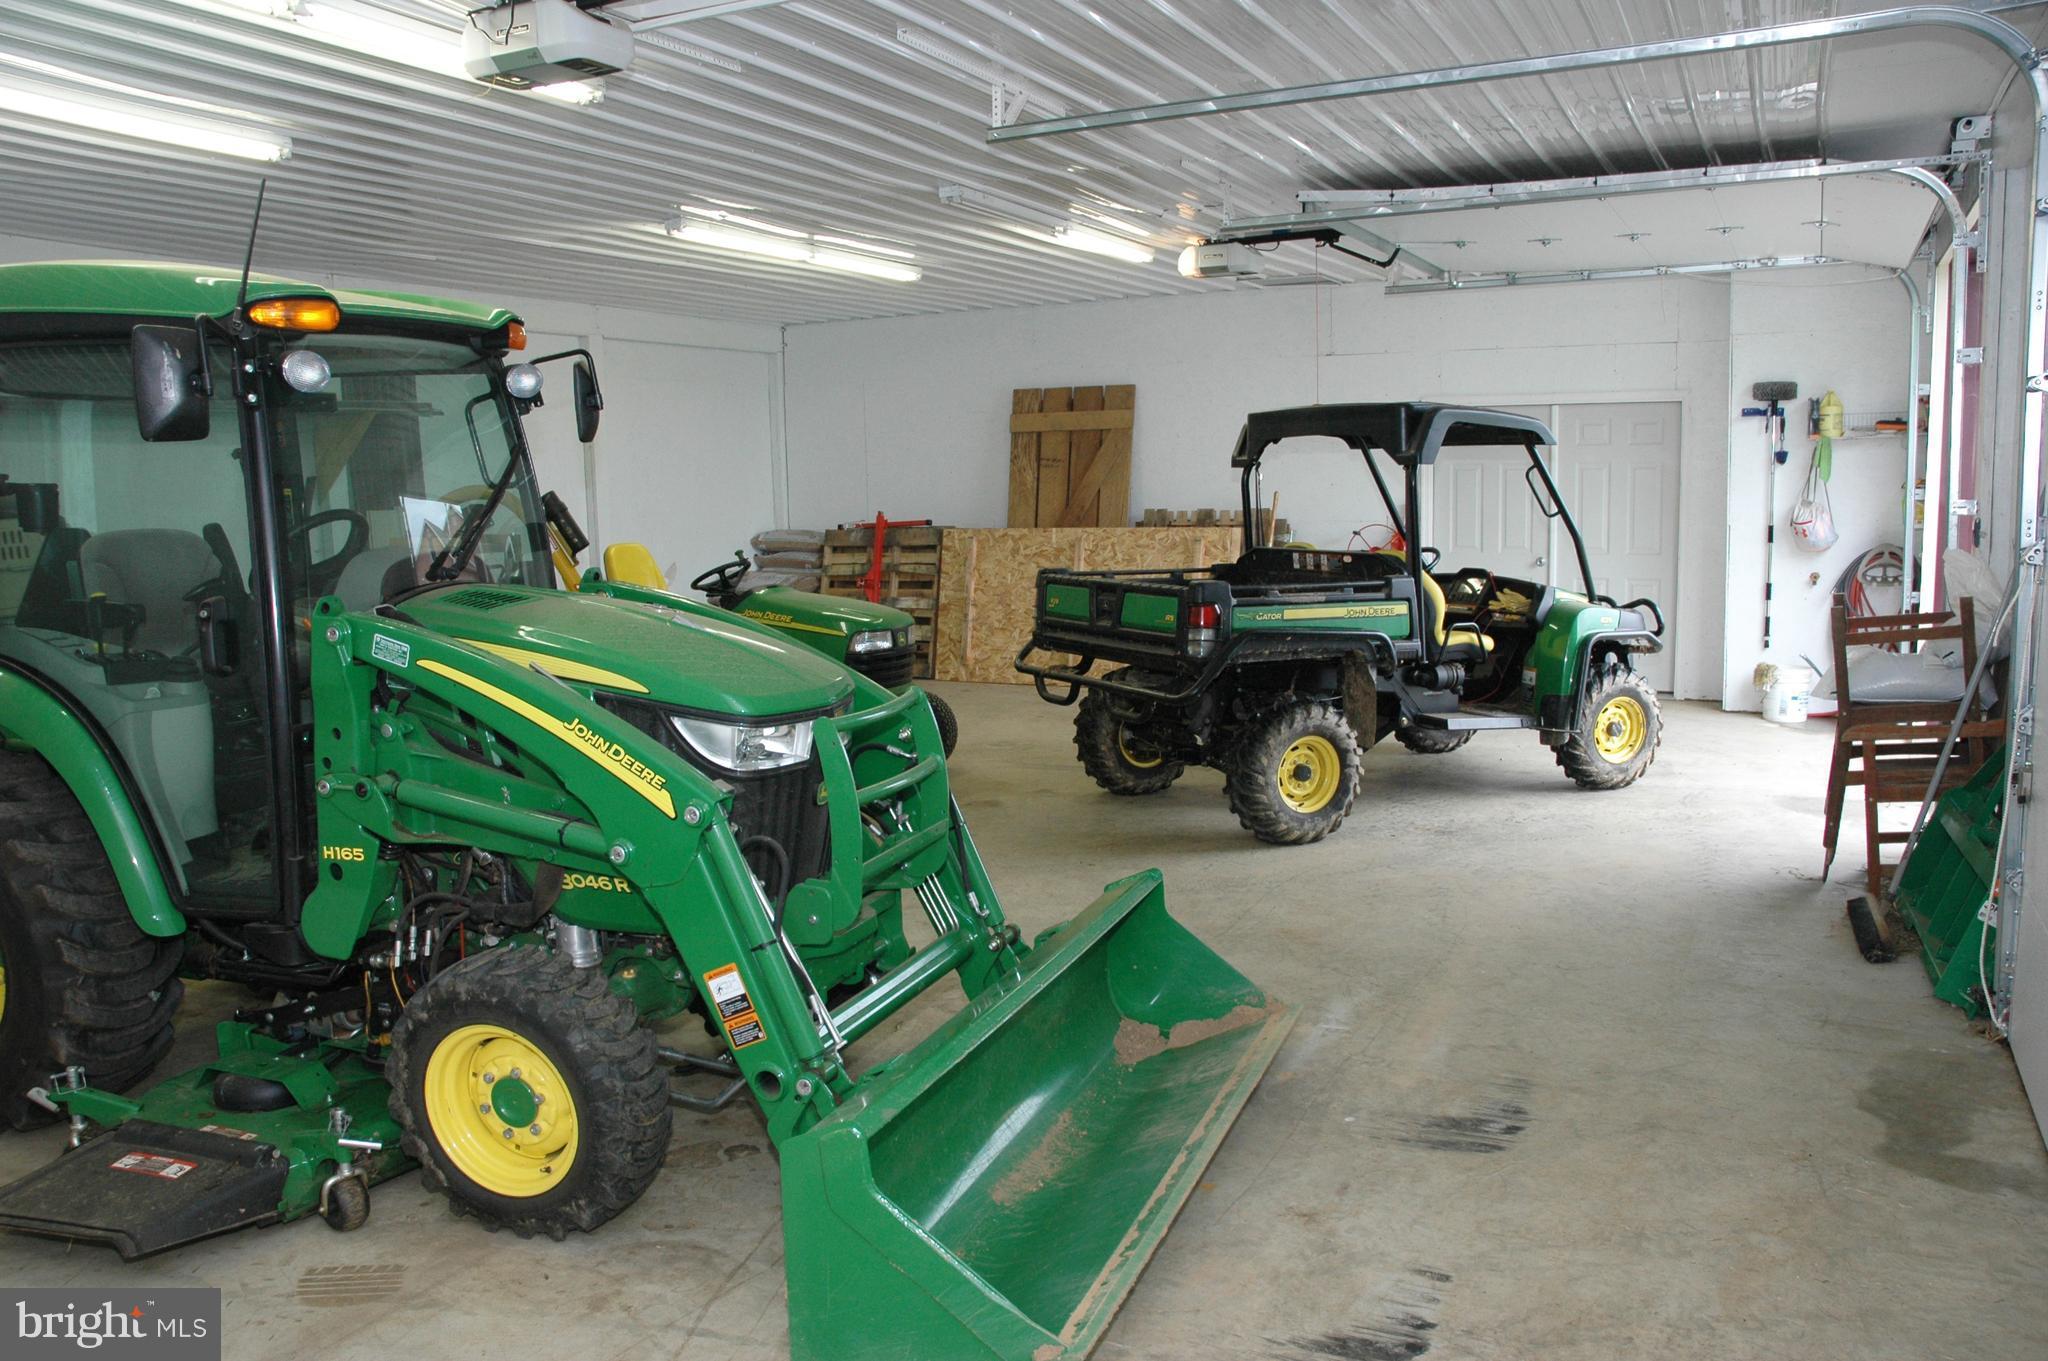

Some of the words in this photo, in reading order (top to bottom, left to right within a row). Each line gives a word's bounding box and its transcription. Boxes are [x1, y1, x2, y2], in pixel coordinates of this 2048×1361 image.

[742, 609, 764, 619] JOHN
[764, 611, 793, 623] DEERE
[1344, 608, 1367, 618] JOHN
[1368, 607, 1396, 616] DEERE
[607, 743, 667, 791] DEERE
[323, 846, 365, 861] H165
